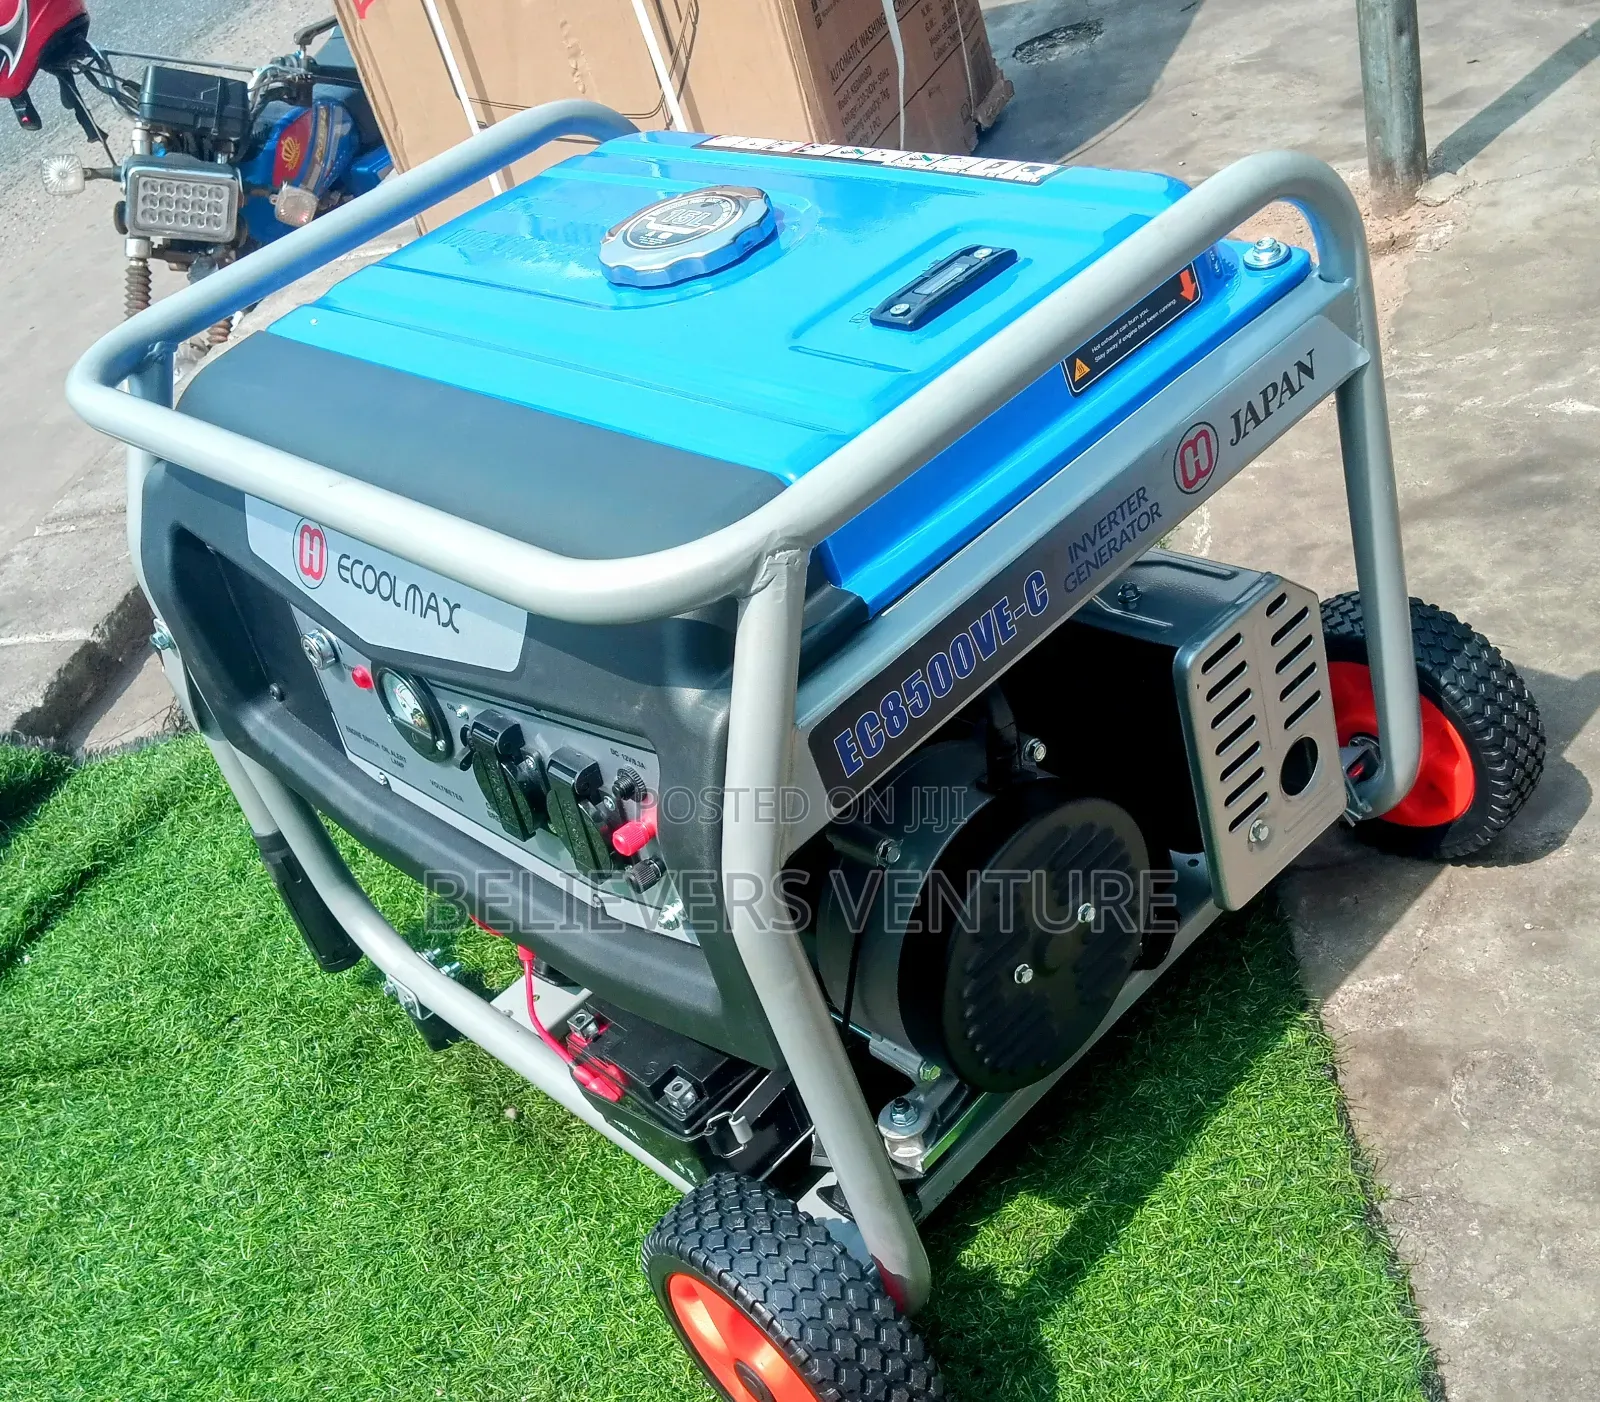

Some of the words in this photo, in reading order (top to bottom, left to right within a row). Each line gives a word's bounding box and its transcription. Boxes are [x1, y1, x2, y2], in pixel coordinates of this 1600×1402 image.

[829, 39, 861, 83] AUTOMATIC
[859, 11, 888, 49] WASHING
[1091, 344, 1101, 353] Hot
[1100, 329, 1120, 347] exhaust
[1119, 323, 1129, 333] can
[1127, 315, 1139, 326] burn
[1138, 308, 1150, 319] you.
[1094, 352, 1106, 363] Stay
[1106, 343, 1119, 355] away
[1122, 328, 1138, 342] engine
[1137, 320, 1147, 330] has
[1146, 311, 1160, 323] been
[1229, 348, 1316, 447] JAPAN
[1063, 501, 1163, 594] GENERATOR
[1067, 486, 1150, 564] INVERTER
[337, 552, 461, 635] ECOOLMAX
[834, 569, 1050, 779] EC8500VE-C
[345, 725, 363, 740] ENGINE
[362, 734, 380, 748] SWITCH
[381, 744, 391, 755] OIL
[390, 749, 407, 764] ALERT
[610, 747, 620, 758] DC
[390, 757, 405, 769] LAMP
[429, 779, 465, 803] VOLTMETER
